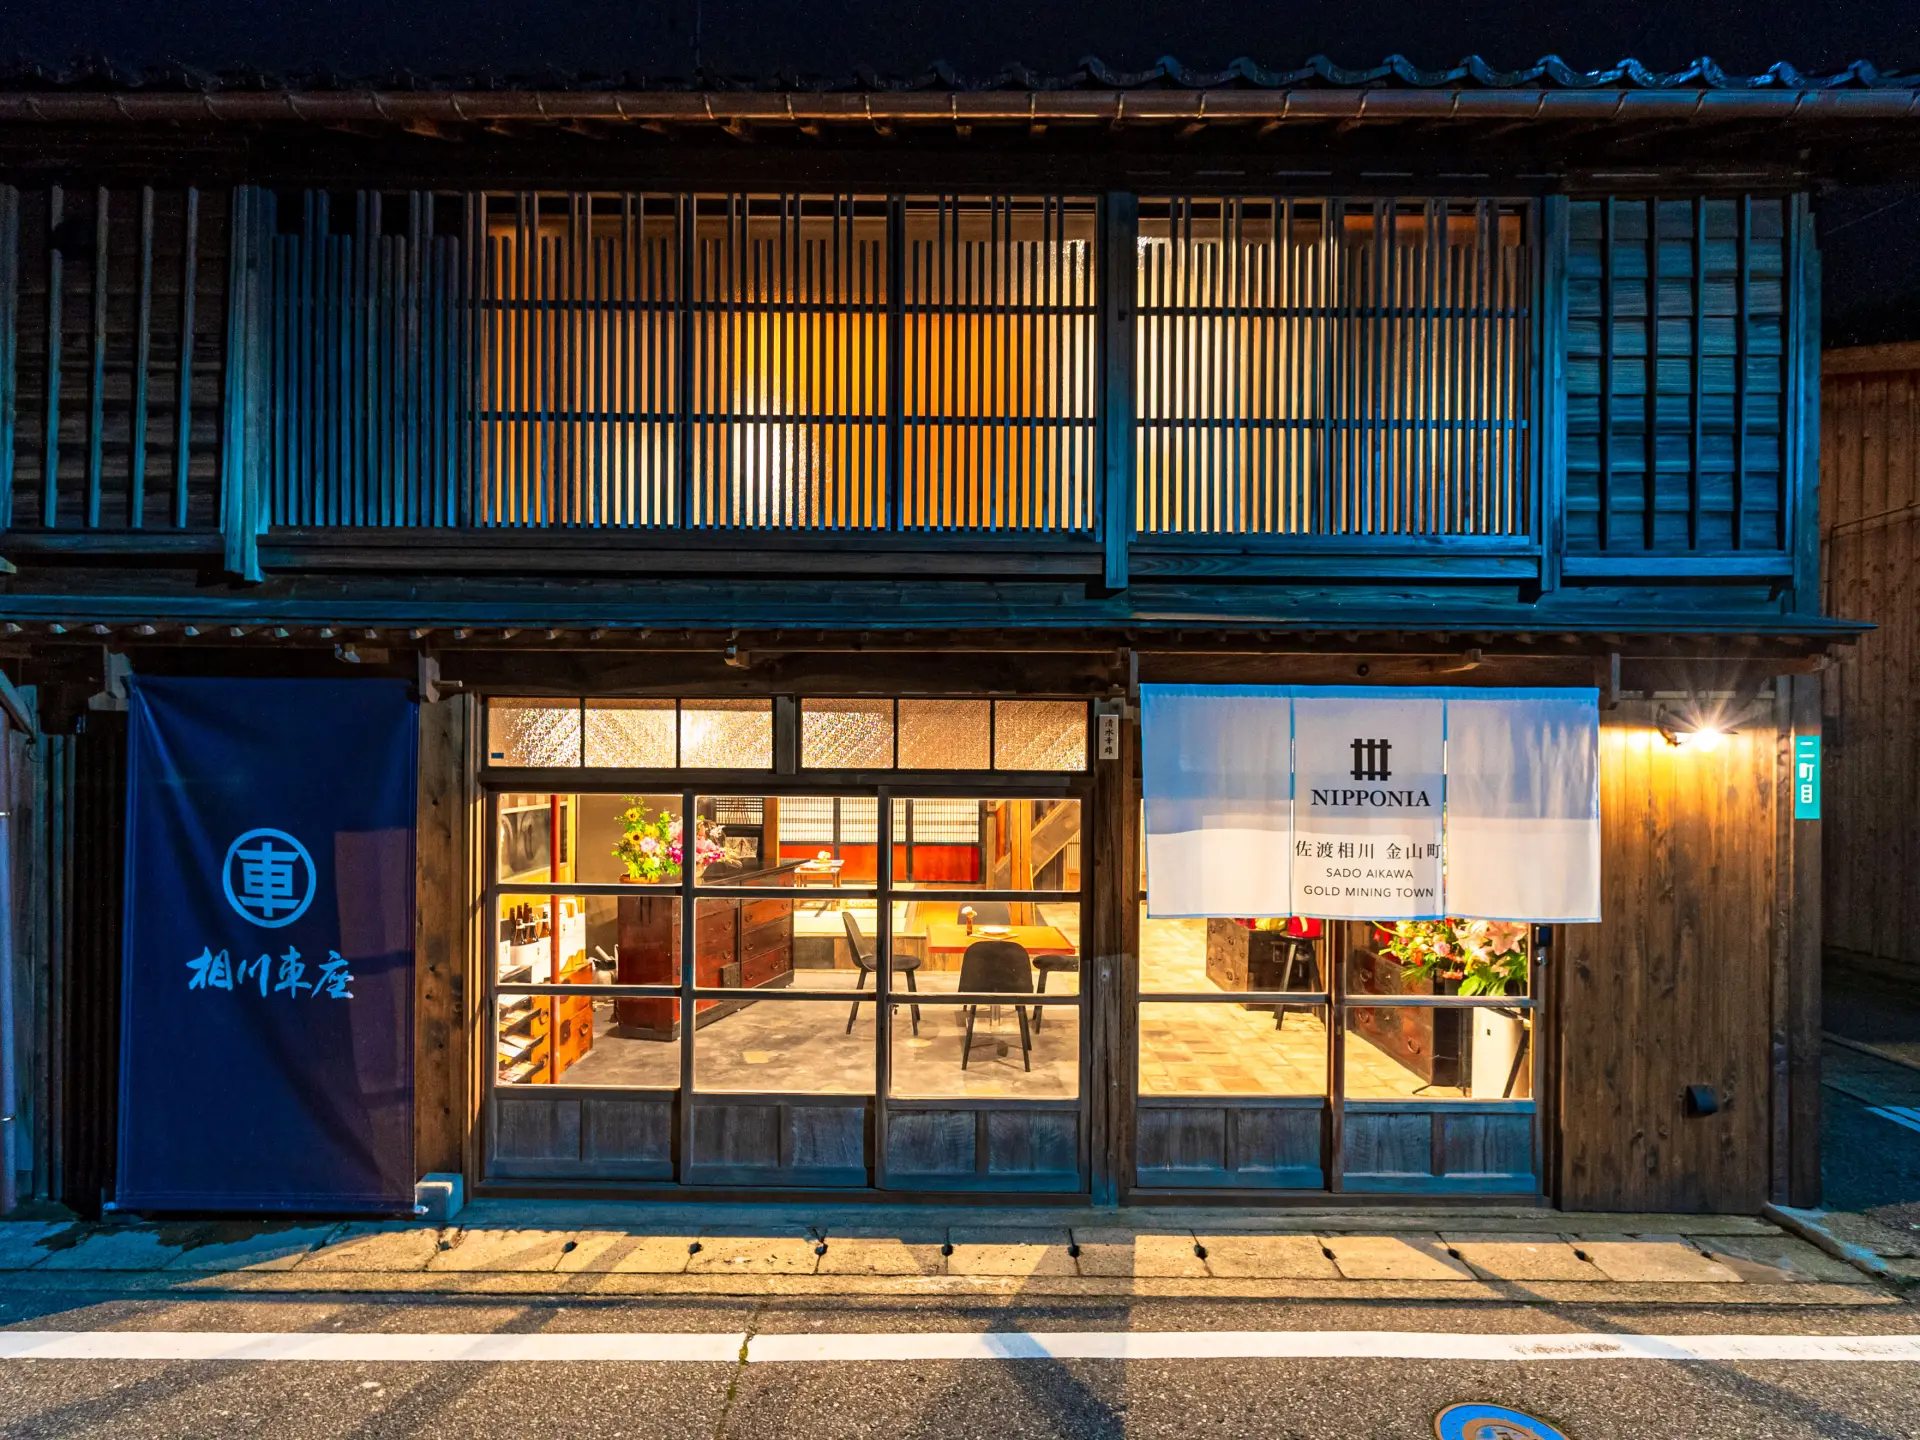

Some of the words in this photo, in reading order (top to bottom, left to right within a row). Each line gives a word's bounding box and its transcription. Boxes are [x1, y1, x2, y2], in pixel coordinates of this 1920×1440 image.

[1799, 742, 1815, 803] 二町目
[1311, 789, 1431, 807] NIPPONIA
[1295, 840, 1375, 860] 佐渡相川
[1386, 841, 1441, 860] 金山町
[236, 841, 304, 918] 車
[1326, 867, 1362, 879] SADO
[1366, 868, 1414, 879] AIKAWA
[1303, 885, 1341, 898] GOLD
[1345, 886, 1391, 898] MINING
[1396, 886, 1434, 898] TOWN
[186, 945, 355, 999] 相川車座
